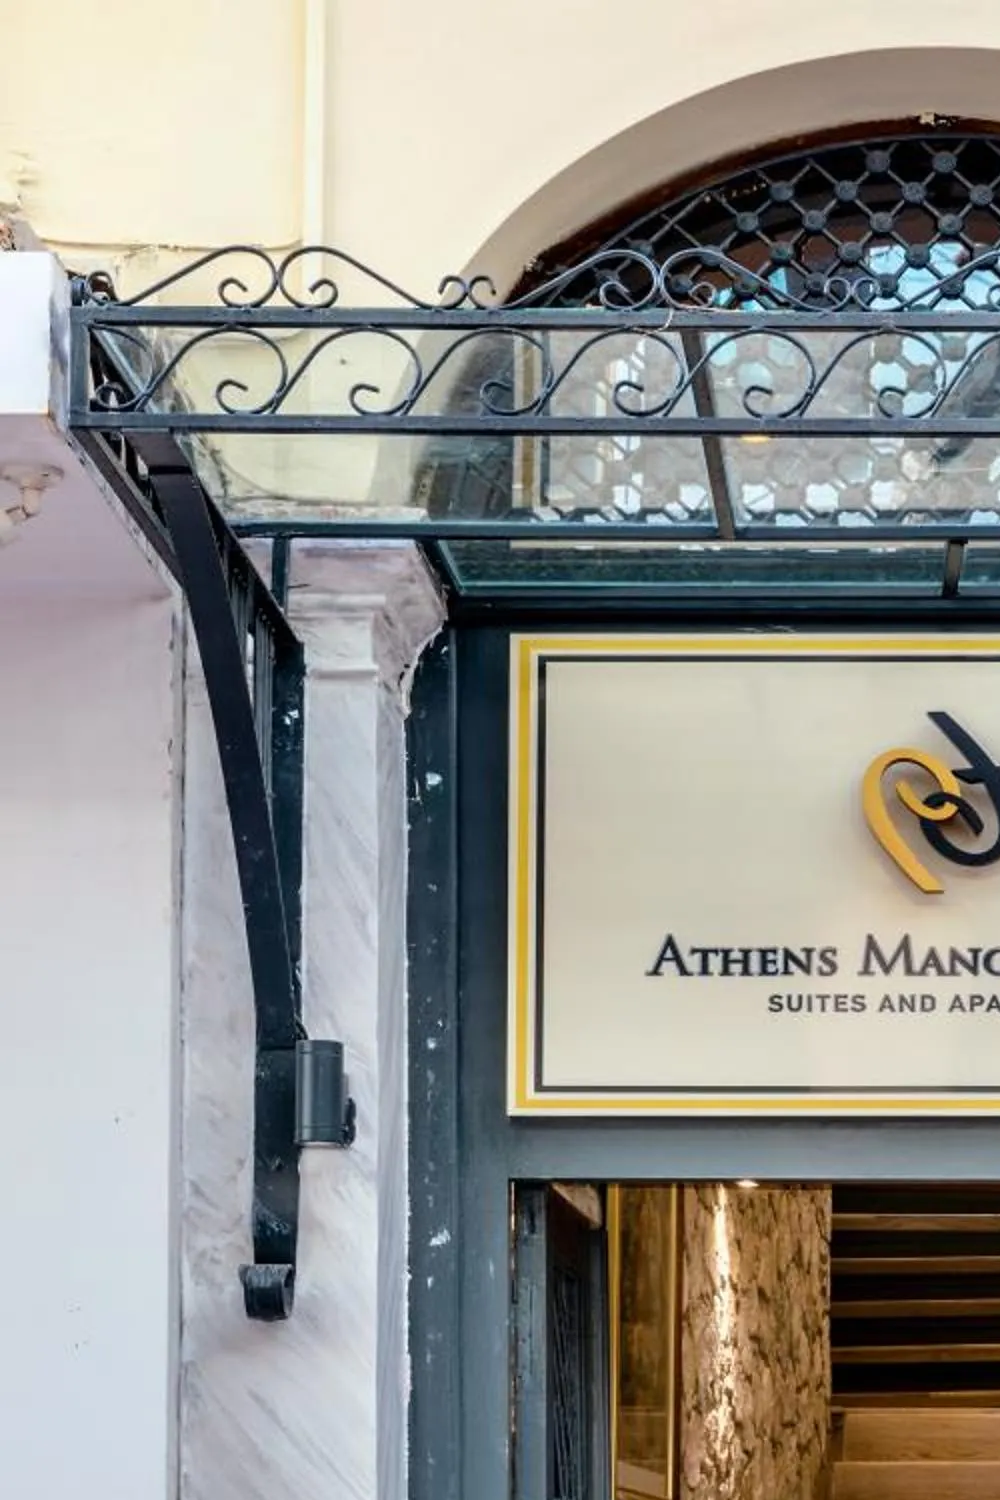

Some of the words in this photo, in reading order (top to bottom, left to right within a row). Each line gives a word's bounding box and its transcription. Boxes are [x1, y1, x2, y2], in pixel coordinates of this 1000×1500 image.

[644, 933, 838, 977] ATHENS
[767, 993, 867, 1013] SUITES
[878, 993, 936, 1013] AND
